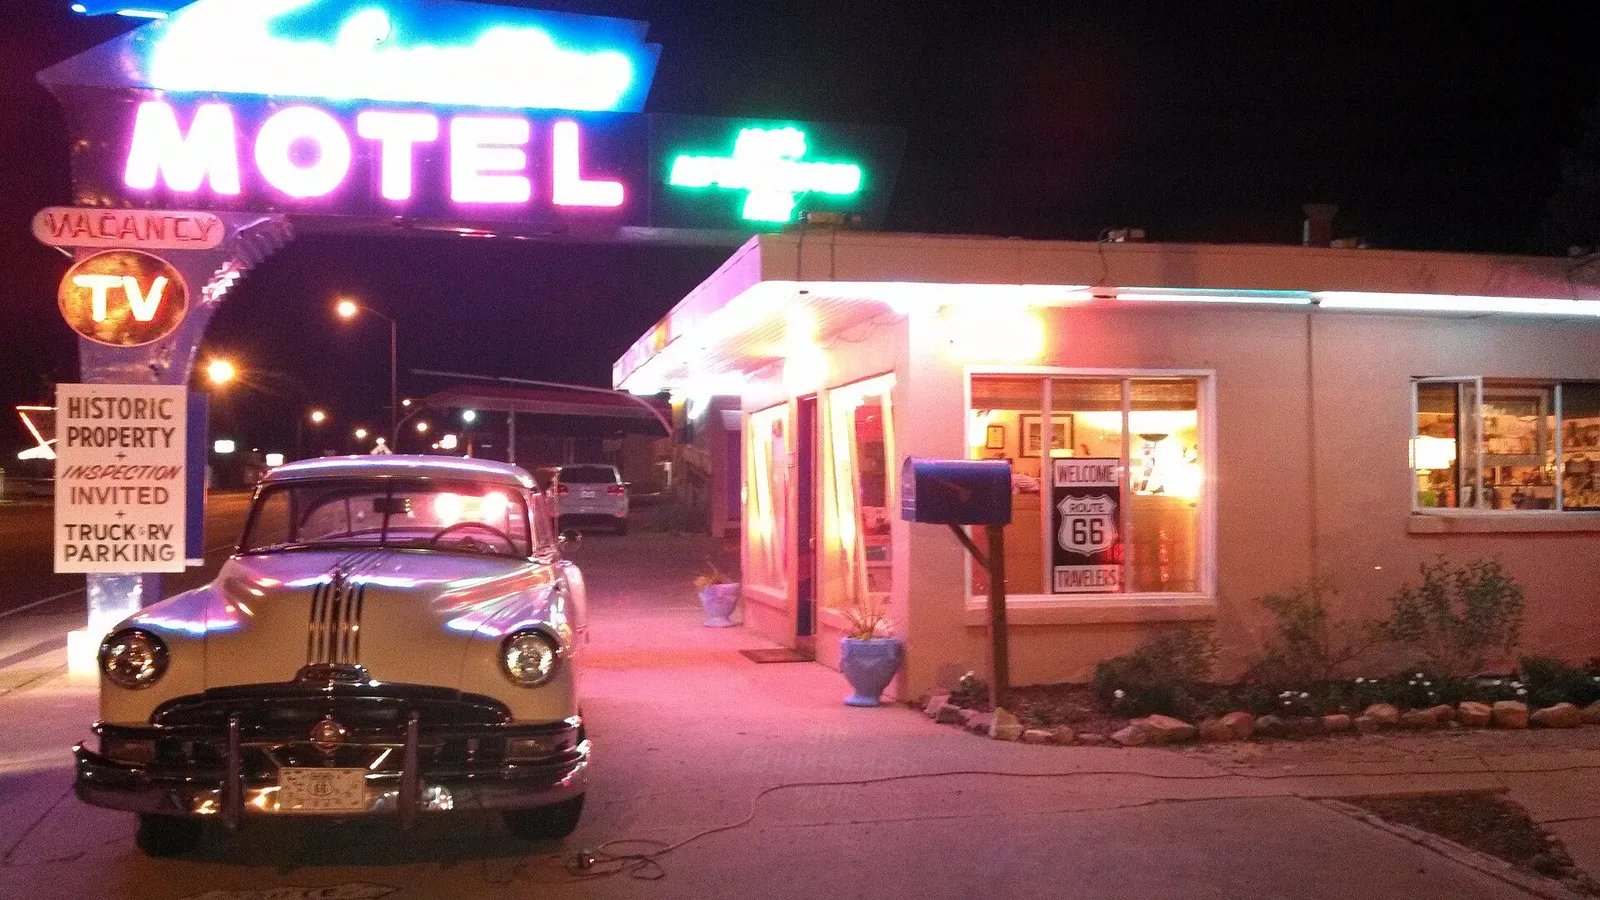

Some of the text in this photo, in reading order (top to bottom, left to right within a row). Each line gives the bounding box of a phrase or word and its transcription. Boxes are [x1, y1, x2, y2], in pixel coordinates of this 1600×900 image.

[124, 101, 625, 207] MOTEL
[48, 212, 217, 242] VACANCY
[73, 274, 169, 323] TV
[68, 397, 173, 420] HISTORIC
[67, 426, 175, 448] PROPERTY
[61, 464, 182, 480] INSPECTION
[1057, 465, 1114, 482] WELCOME
[70, 486, 168, 505] INVITED
[1069, 503, 1105, 513] ROUTE
[64, 523, 135, 540] TRUCK
[149, 524, 174, 540] RV
[1073, 518, 1103, 545] 66
[65, 544, 176, 562] PARKING
[1057, 569, 1118, 588] TRAVELERS
